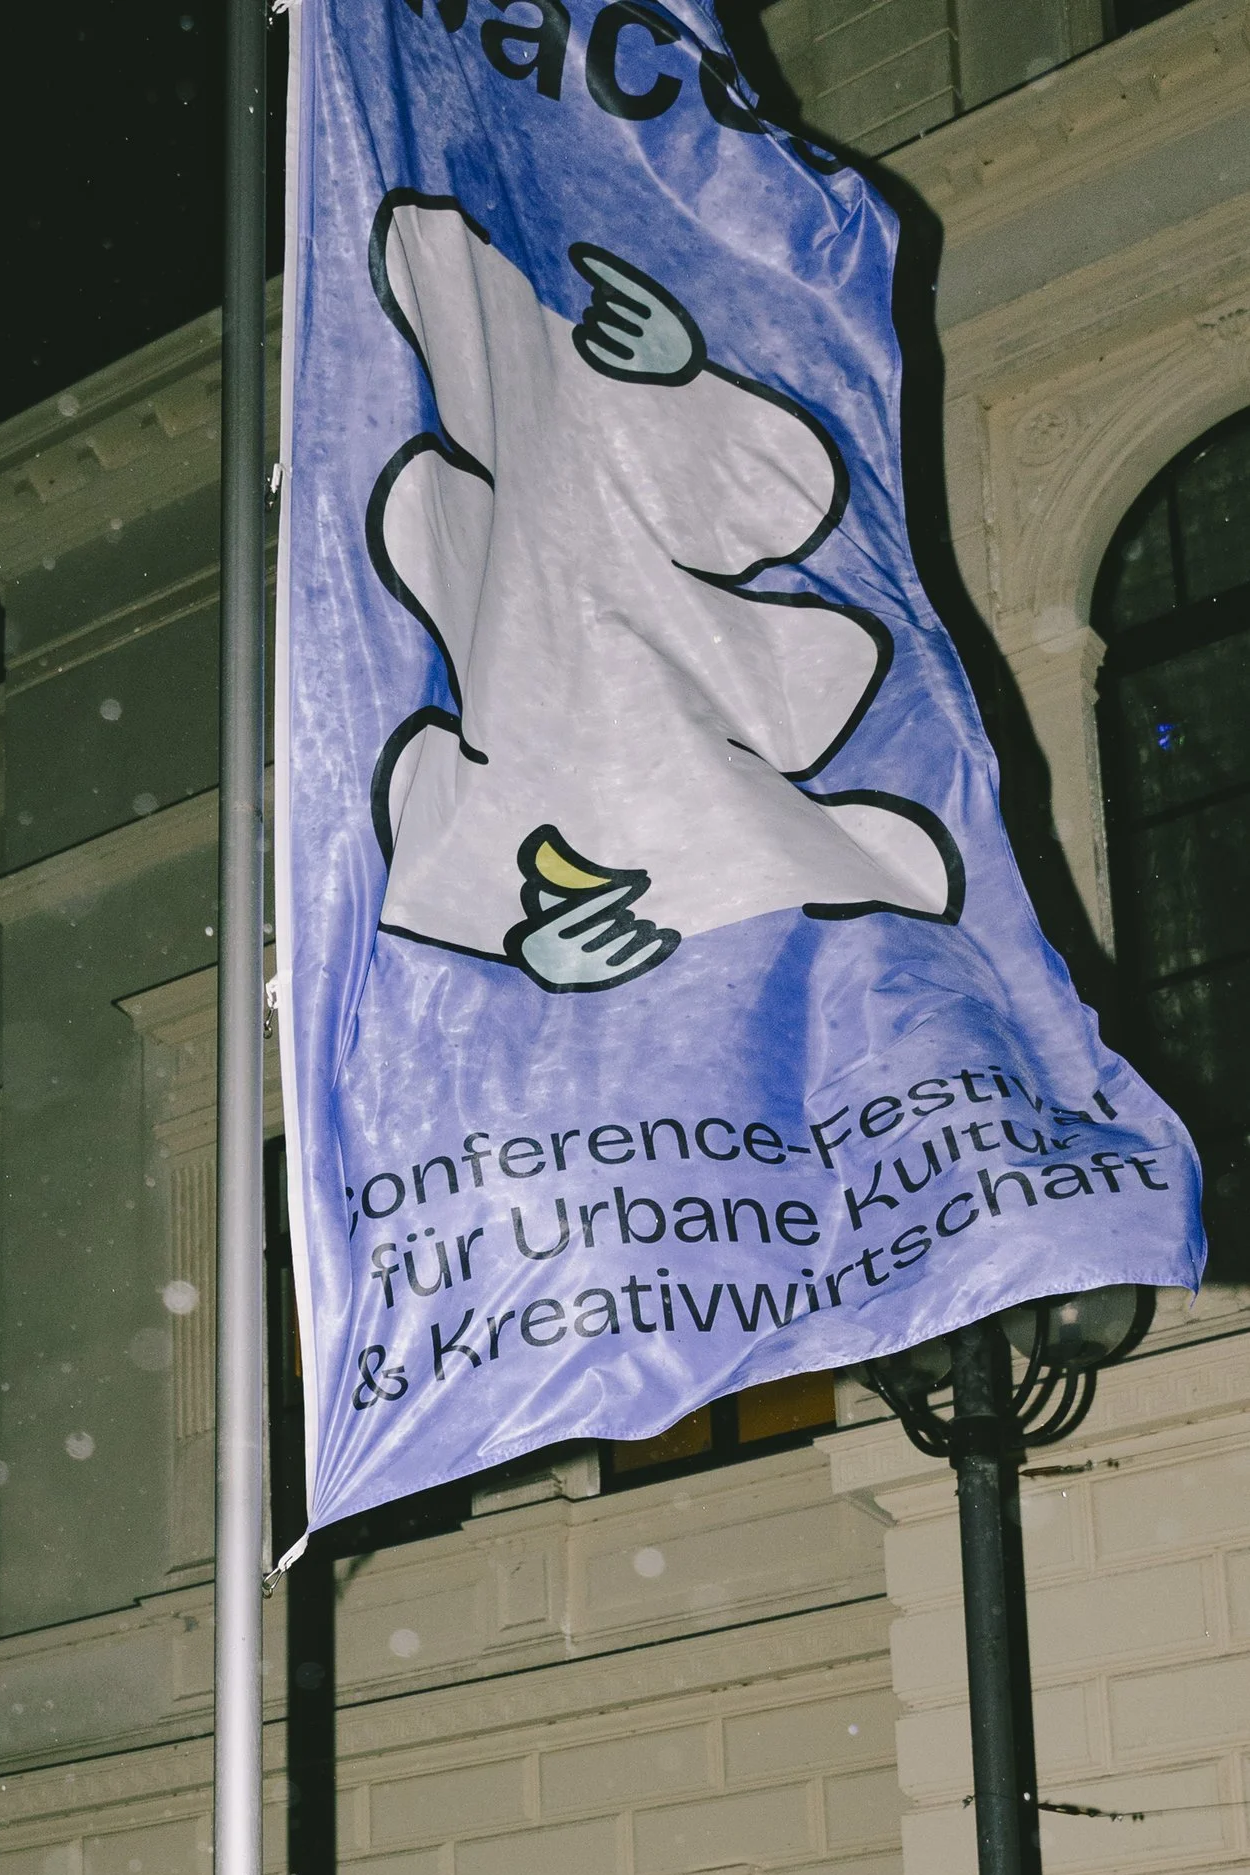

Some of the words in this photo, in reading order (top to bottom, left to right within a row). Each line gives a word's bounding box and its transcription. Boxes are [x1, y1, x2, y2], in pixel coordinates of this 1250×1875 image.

[351, 1344, 409, 1410] &
[430, 1152, 1170, 1381] Kreativwirtschaft
[371, 1227, 485, 1309] für
[510, 1187, 819, 1260] Urbane
[844, 1119, 1081, 1230] Kultur
